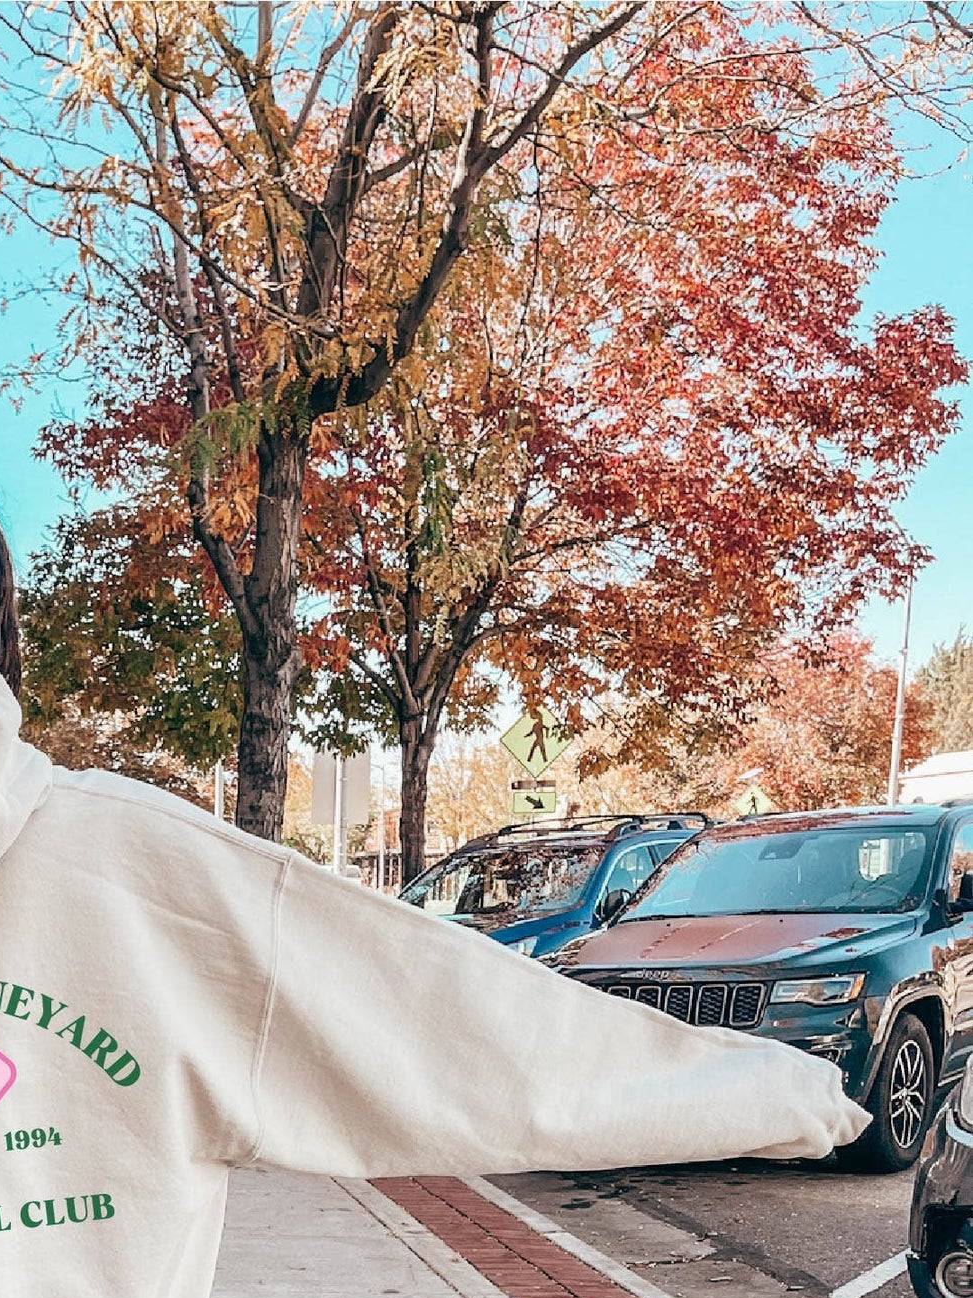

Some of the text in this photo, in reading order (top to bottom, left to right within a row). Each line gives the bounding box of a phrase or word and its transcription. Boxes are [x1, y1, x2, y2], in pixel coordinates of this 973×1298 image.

[637, 968, 669, 980] Jeep
[3, 1126, 63, 1152] 1994
[19, 1192, 116, 1229] CLUB
